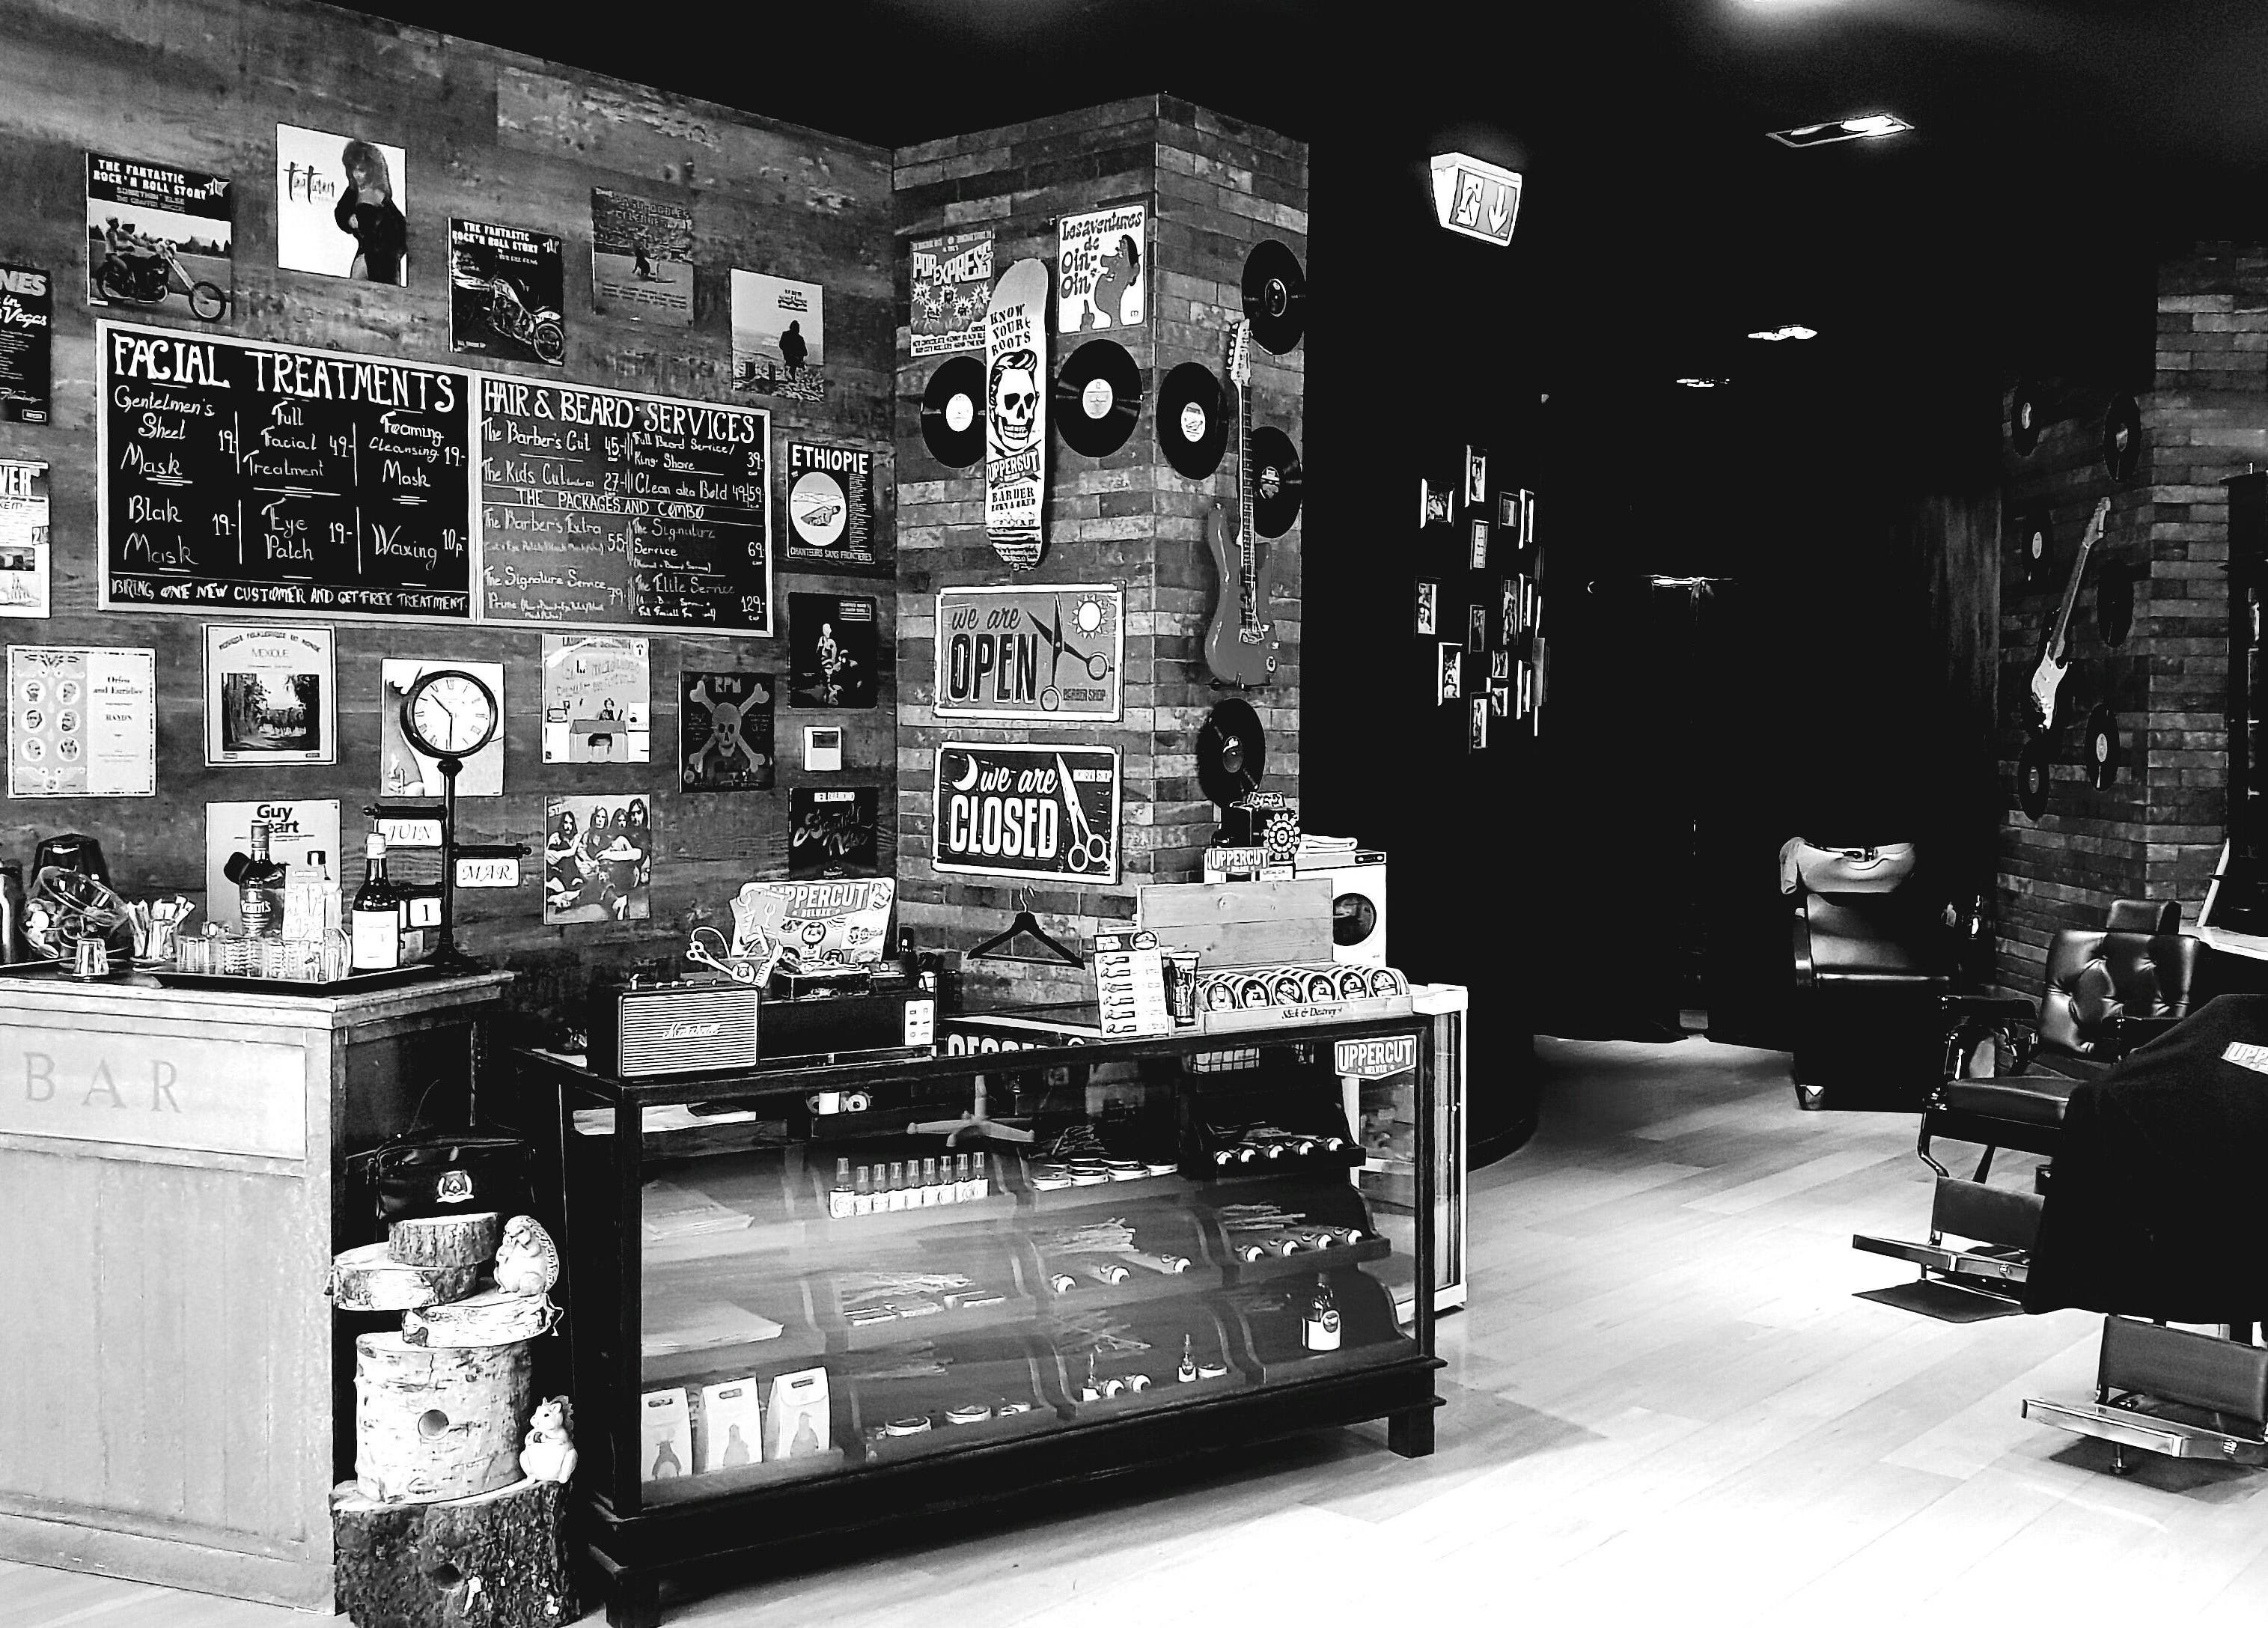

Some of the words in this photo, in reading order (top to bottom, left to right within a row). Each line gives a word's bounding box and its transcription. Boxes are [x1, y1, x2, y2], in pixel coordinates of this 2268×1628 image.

[98, 159, 120, 172] THE
[126, 165, 184, 184] FANTASTIC
[463, 222, 481, 233] THE
[1084, 236, 1100, 251] de
[912, 251, 936, 278] POP
[991, 331, 1031, 356] ROOTS
[112, 332, 231, 388] FACIAL
[244, 350, 454, 412] TREATMENTS
[271, 400, 304, 426] Full
[484, 380, 531, 417] HAIR
[534, 389, 555, 420] &
[643, 400, 755, 444] SERVICES
[261, 425, 317, 450] Facial
[481, 416, 503, 442] The
[505, 419, 563, 450] Barber's
[632, 431, 653, 445] Full
[120, 442, 183, 475] Mask
[368, 436, 439, 463] Cleansing
[792, 444, 869, 475] ETHIOPIE
[382, 459, 431, 487] Mask
[481, 457, 503, 483] The
[505, 460, 537, 485] Kids
[515, 488, 545, 507] THE
[558, 492, 621, 513] PACKAGES
[624, 499, 650, 516] AND
[657, 501, 704, 519] COMBO
[261, 497, 308, 538] Eye
[484, 507, 502, 529] The
[632, 516, 647, 534] The
[124, 532, 199, 565] Mask
[372, 523, 438, 570] Waxing
[484, 564, 502, 587] The
[112, 578, 154, 600] BRING
[160, 582, 192, 600] ONE
[196, 582, 228, 600] NEW
[311, 588, 335, 604] AND
[338, 589, 360, 604] GET
[359, 591, 394, 606] FREE
[951, 607, 979, 630] we
[987, 607, 1021, 630] are
[947, 633, 1038, 704] OPEN
[980, 766, 1012, 793] we
[1017, 767, 1058, 795] are
[257, 804, 293, 823] Guy
[267, 820, 299, 834] éart
[949, 793, 1059, 859] CLOSED
[462, 865, 513, 882] MAR
[1208, 850, 1269, 871] UPPERCUT
[423, 904, 430, 921] 1
[1338, 1039, 1412, 1071] UPPERCUT
[23, 1051, 183, 1114] BAR
